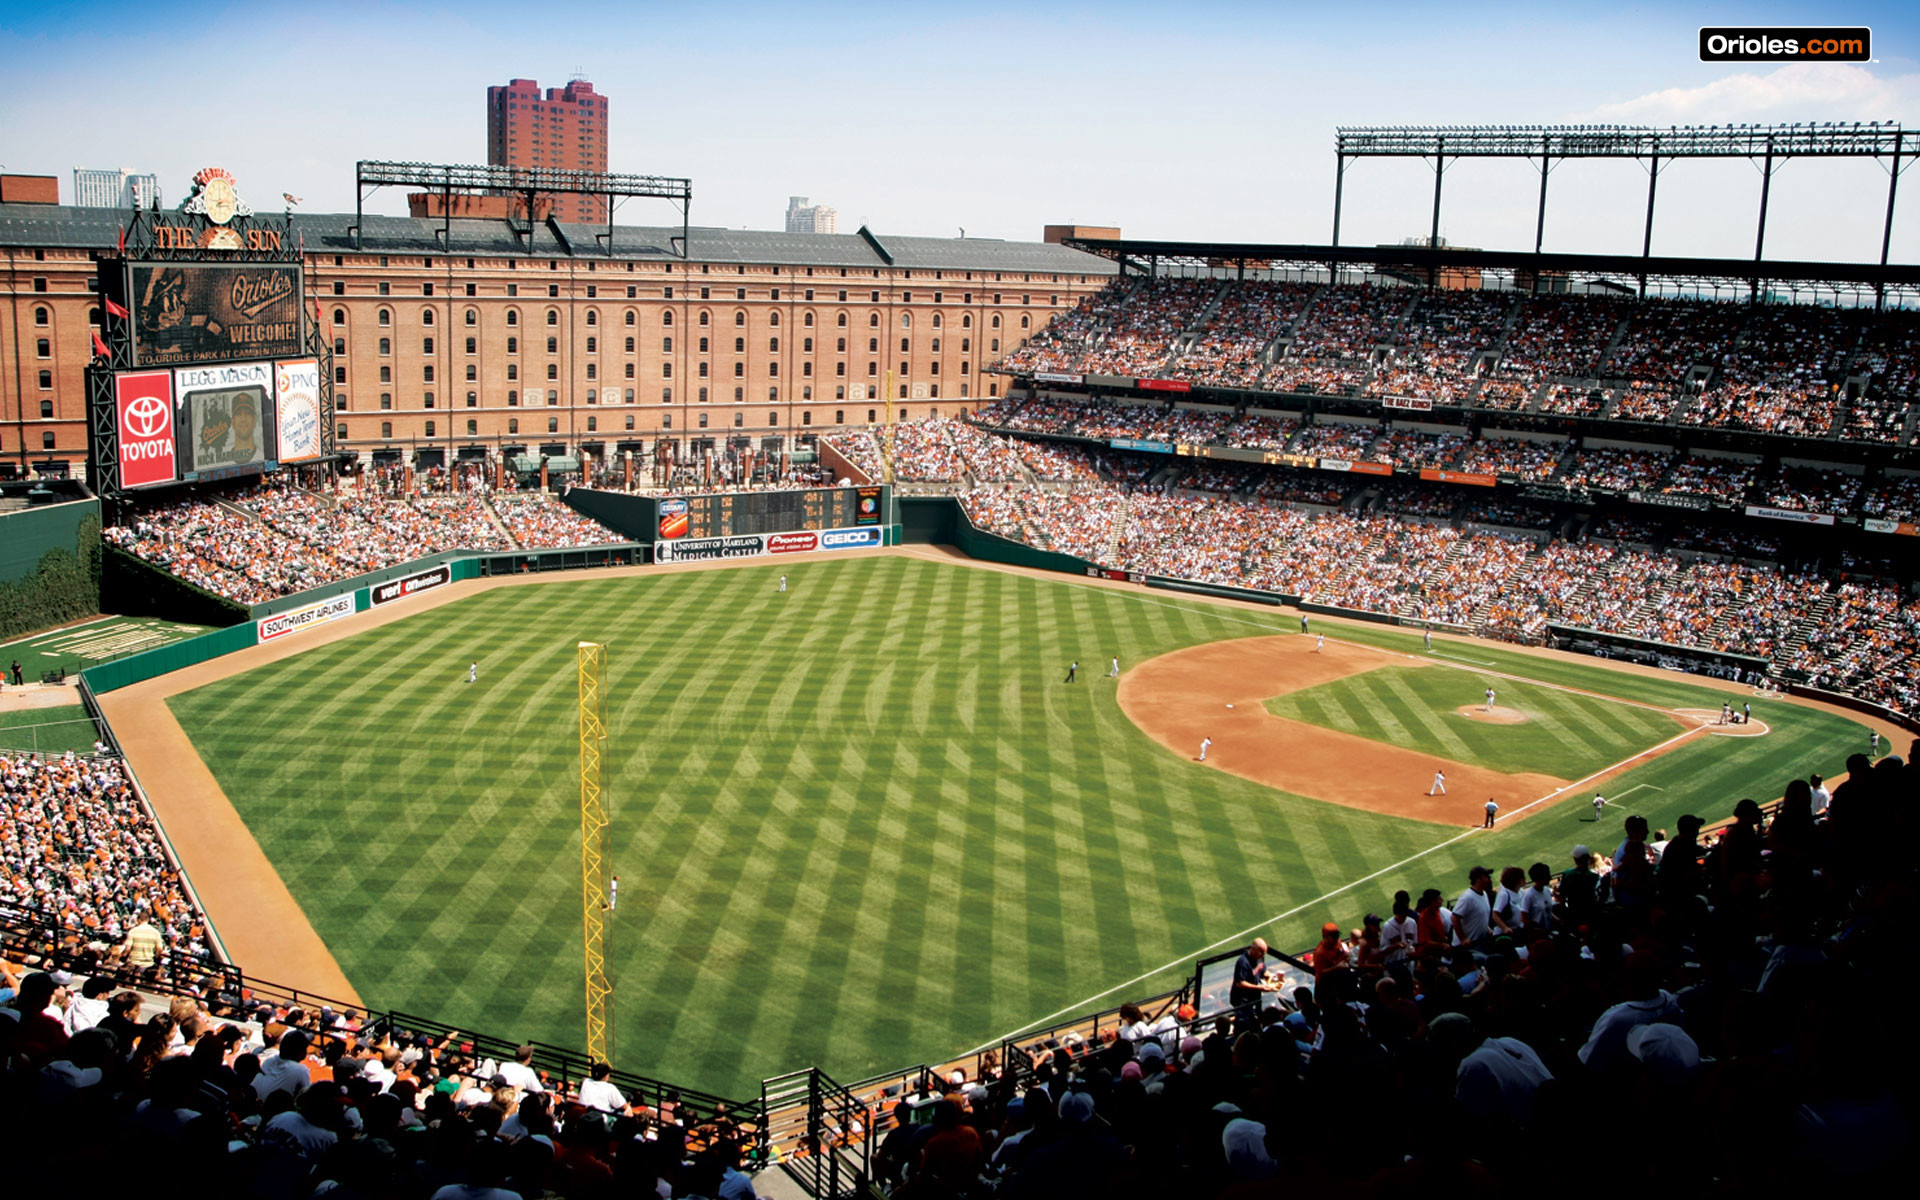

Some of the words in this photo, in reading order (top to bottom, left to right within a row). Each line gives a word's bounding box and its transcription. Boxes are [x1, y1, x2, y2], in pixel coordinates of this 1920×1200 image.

[153, 226, 194, 249] THE
[247, 230, 281, 251] SUN
[231, 270, 293, 312] Orioles
[229, 322, 296, 344] WELCOME!
[156, 351, 191, 363] ORIOLE
[193, 349, 218, 360] PARK
[220, 350, 231, 358] AT
[233, 346, 269, 358] CAMDEN
[181, 370, 216, 387] LEGG
[219, 366, 267, 384] MASON
[291, 373, 317, 389] PNC
[121, 437, 174, 462] TOYOTA
[1643, 498, 1700, 509] LEGENDS
[673, 541, 712, 551] UNIVERSITY
[722, 537, 759, 548] MARYLAND
[771, 536, 816, 545] Pioneer
[823, 531, 870, 545] GEICO
[673, 552, 716, 561] MEDICAL
[721, 547, 763, 558] CENTER
[266, 610, 315, 634] SOUTHWEST
[316, 600, 349, 618] AIRLINES
